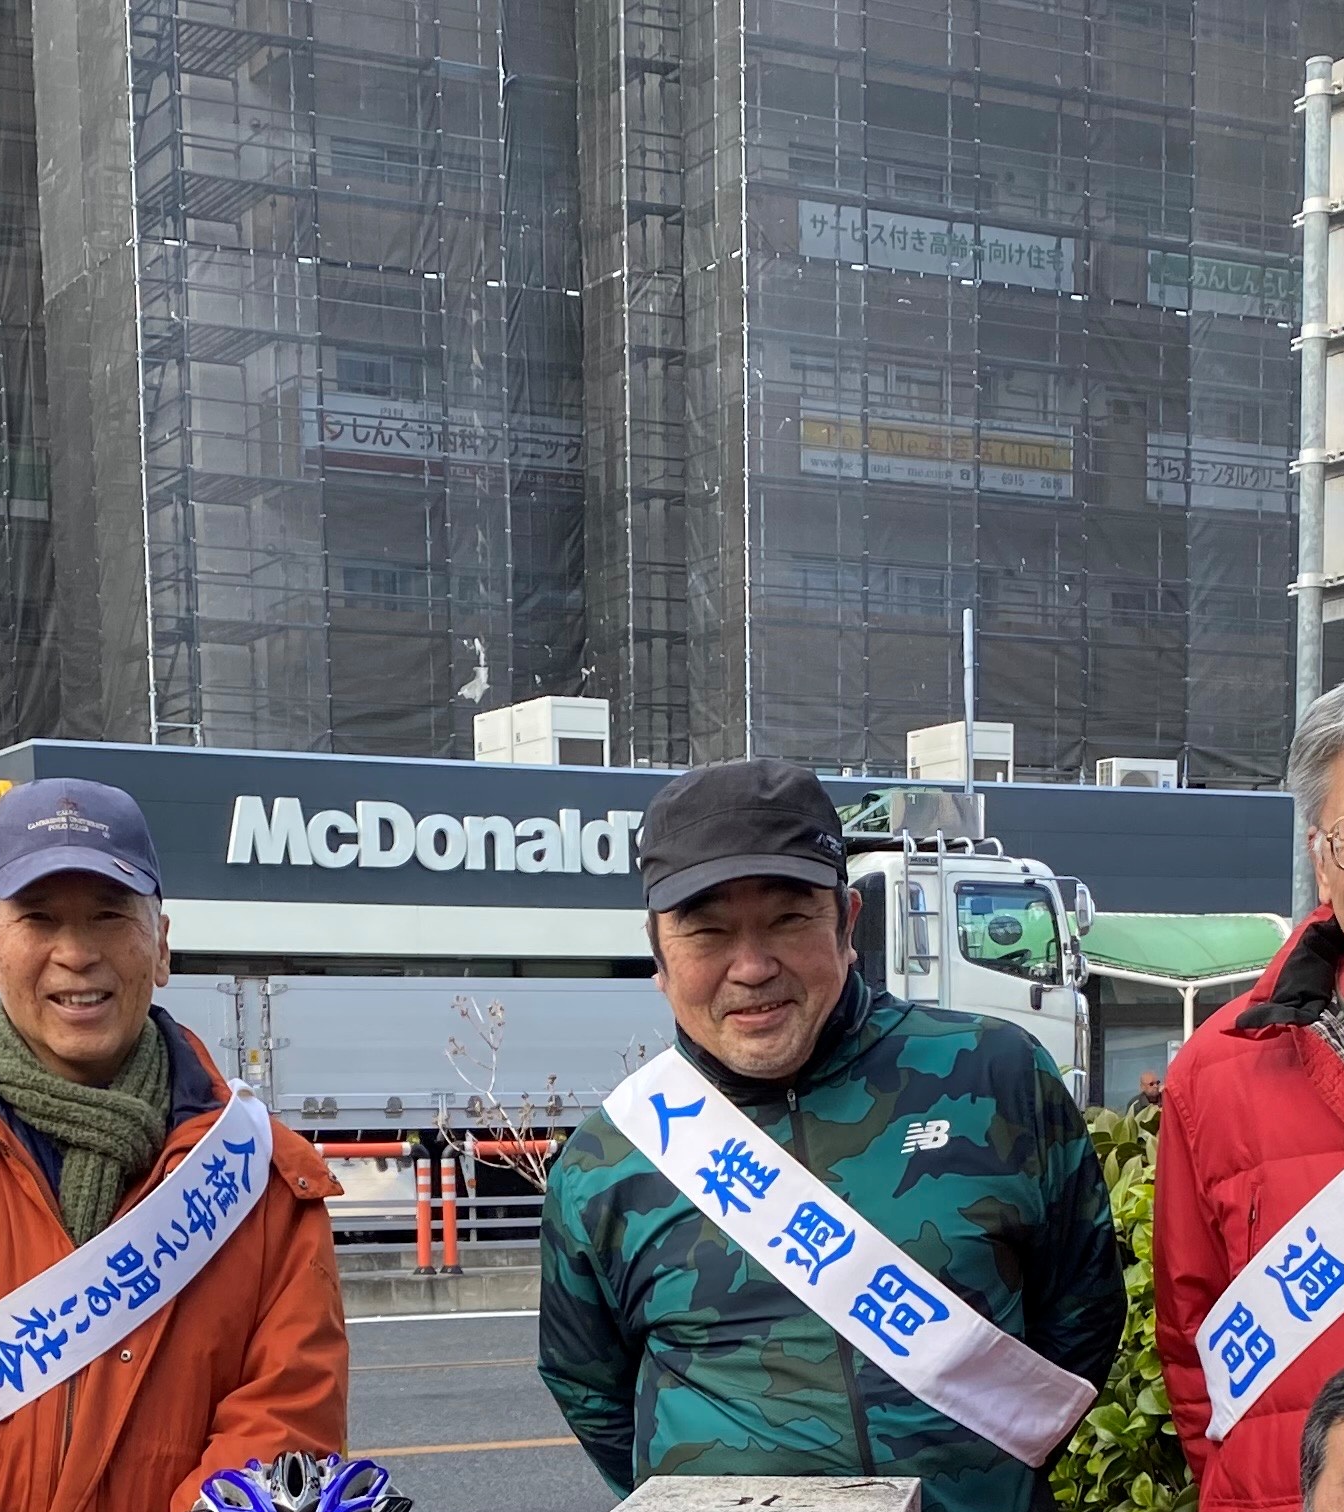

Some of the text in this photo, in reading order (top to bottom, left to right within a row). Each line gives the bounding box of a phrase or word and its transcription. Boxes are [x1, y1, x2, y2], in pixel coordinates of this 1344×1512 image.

[226, 795, 644, 876] McDonald'
[648, 1092, 951, 1358] 人権週間
